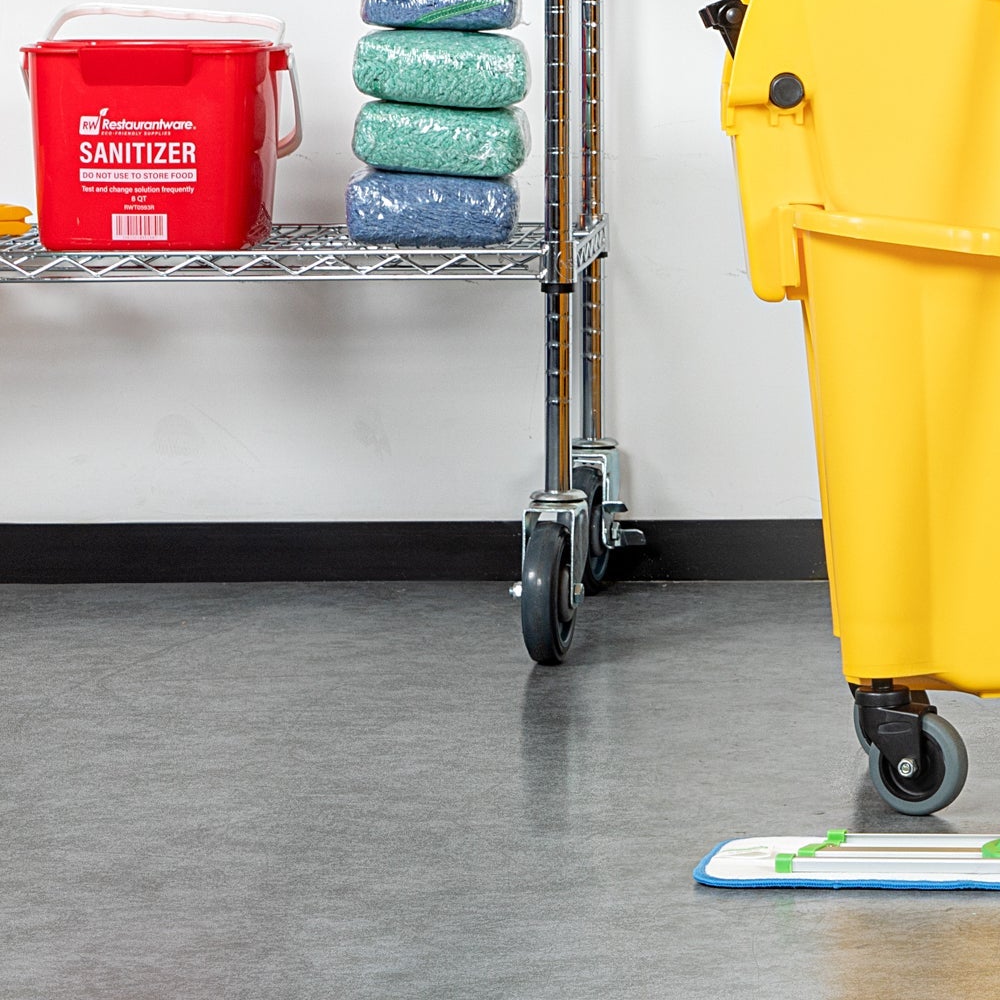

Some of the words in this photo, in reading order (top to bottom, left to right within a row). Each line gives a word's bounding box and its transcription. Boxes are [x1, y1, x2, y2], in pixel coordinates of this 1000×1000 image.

[79, 141, 196, 164] SANITIZER
[109, 186, 133, 194] change
[161, 186, 194, 194] frequently
